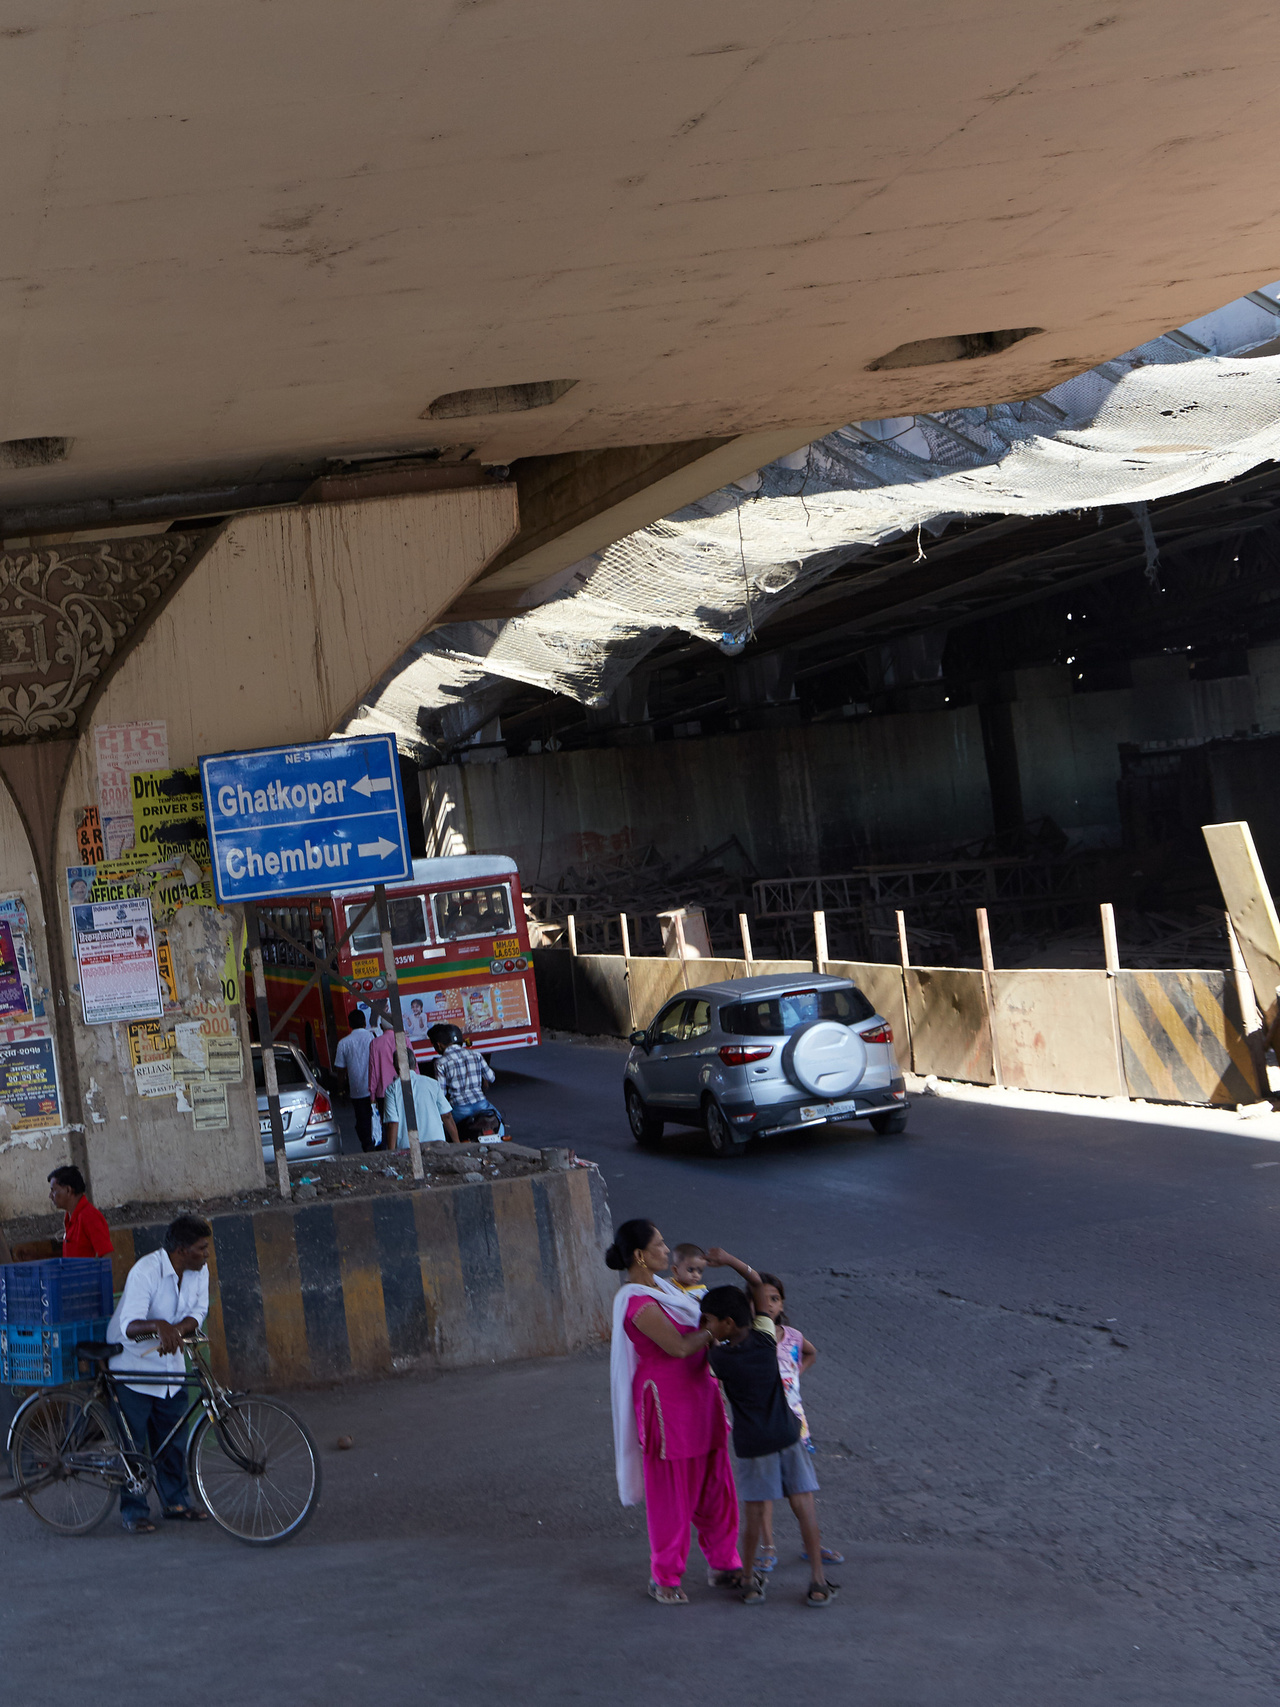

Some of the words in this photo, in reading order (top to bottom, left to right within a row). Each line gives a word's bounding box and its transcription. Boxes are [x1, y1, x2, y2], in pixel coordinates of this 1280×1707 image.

[285, 754, 311, 764] NE-5
[133, 774, 162, 799] Driv
[218, 779, 347, 816] Ghatkopar
[143, 804, 188, 816] DRIVER
[191, 802, 205, 811] SE
[92, 828, 102, 843] R
[80, 845, 104, 865] 810
[226, 839, 352, 879] Chembur
[496, 940, 516, 948] MH.01
[494, 947, 520, 958] LA.6530
